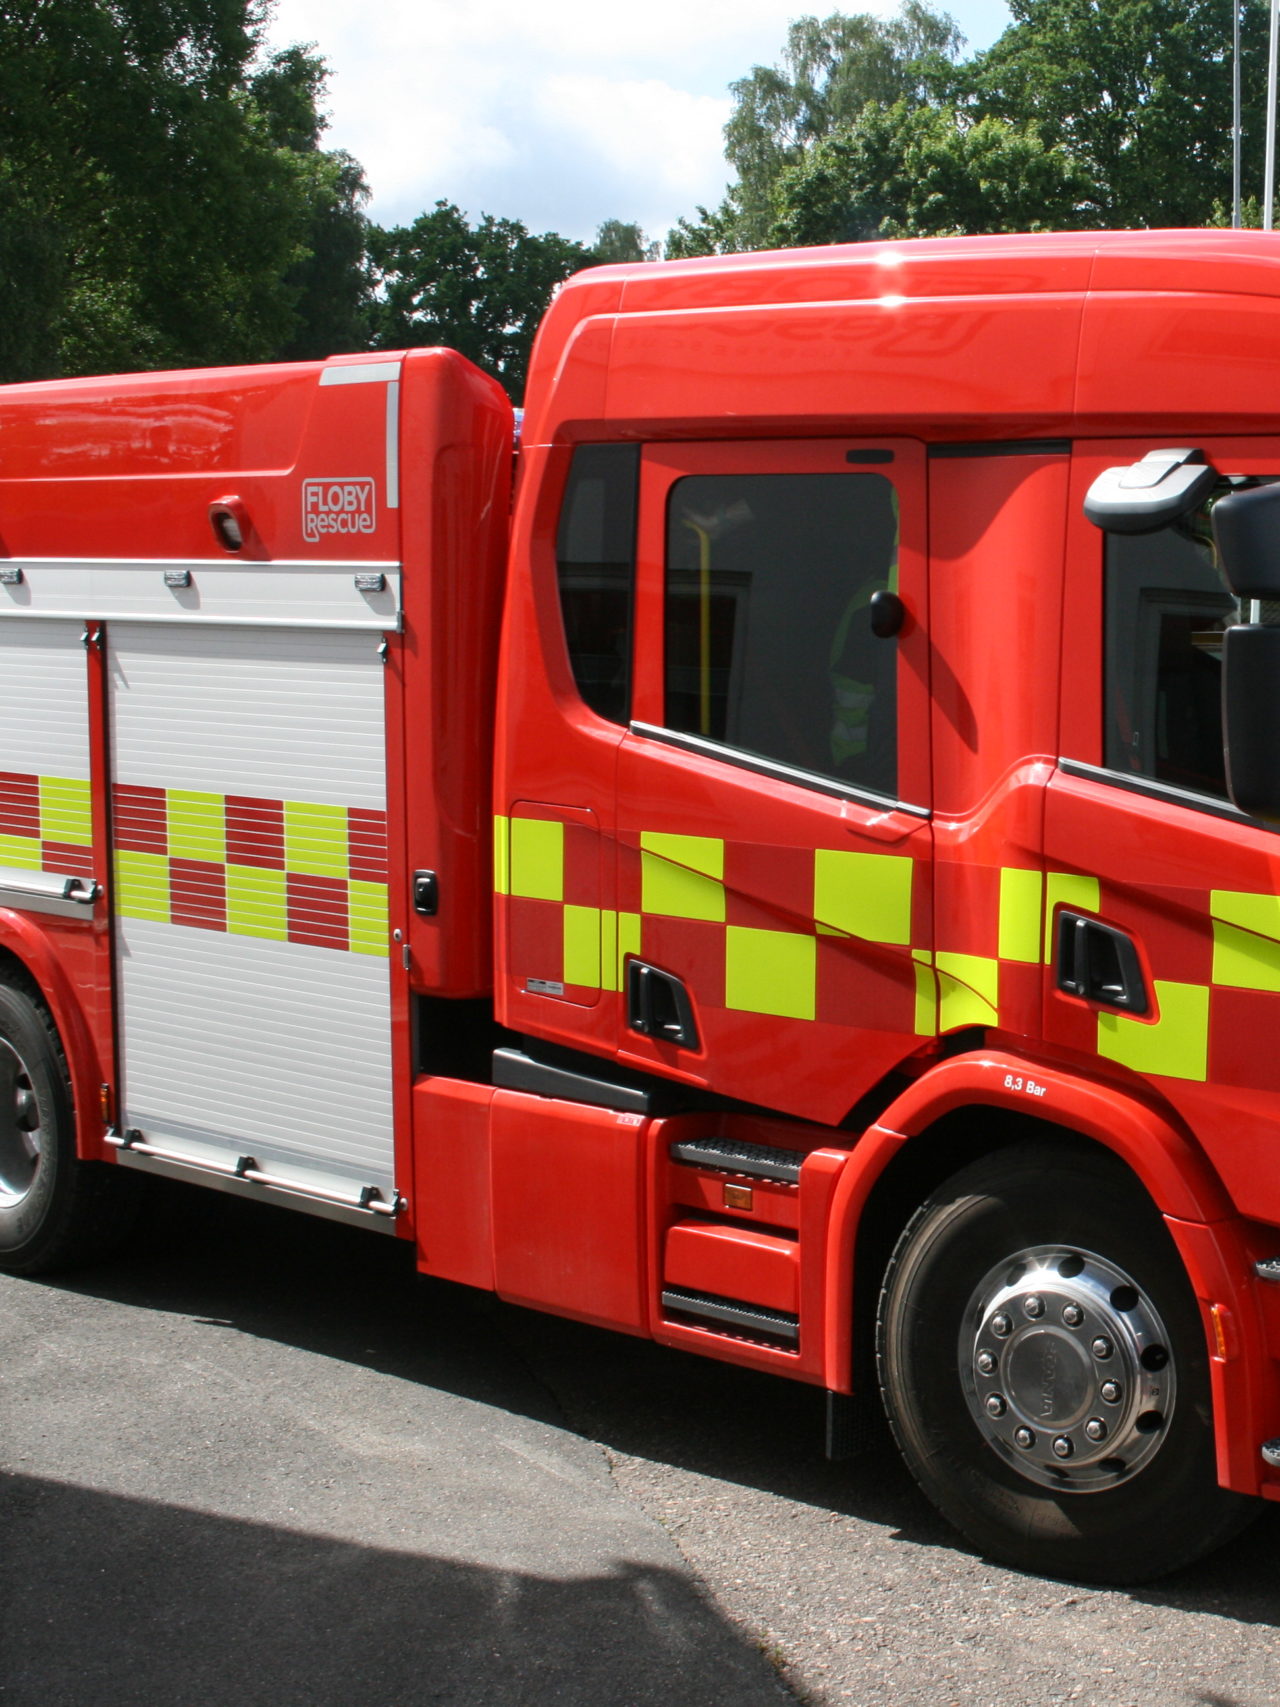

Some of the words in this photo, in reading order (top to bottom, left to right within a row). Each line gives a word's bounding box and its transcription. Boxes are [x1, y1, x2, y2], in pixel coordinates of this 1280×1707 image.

[306, 485, 370, 512] FLOBY
[306, 513, 372, 534] Rescue
[1003, 1074, 1023, 1091] 8,3
[1025, 1080, 1047, 1097] Bar
